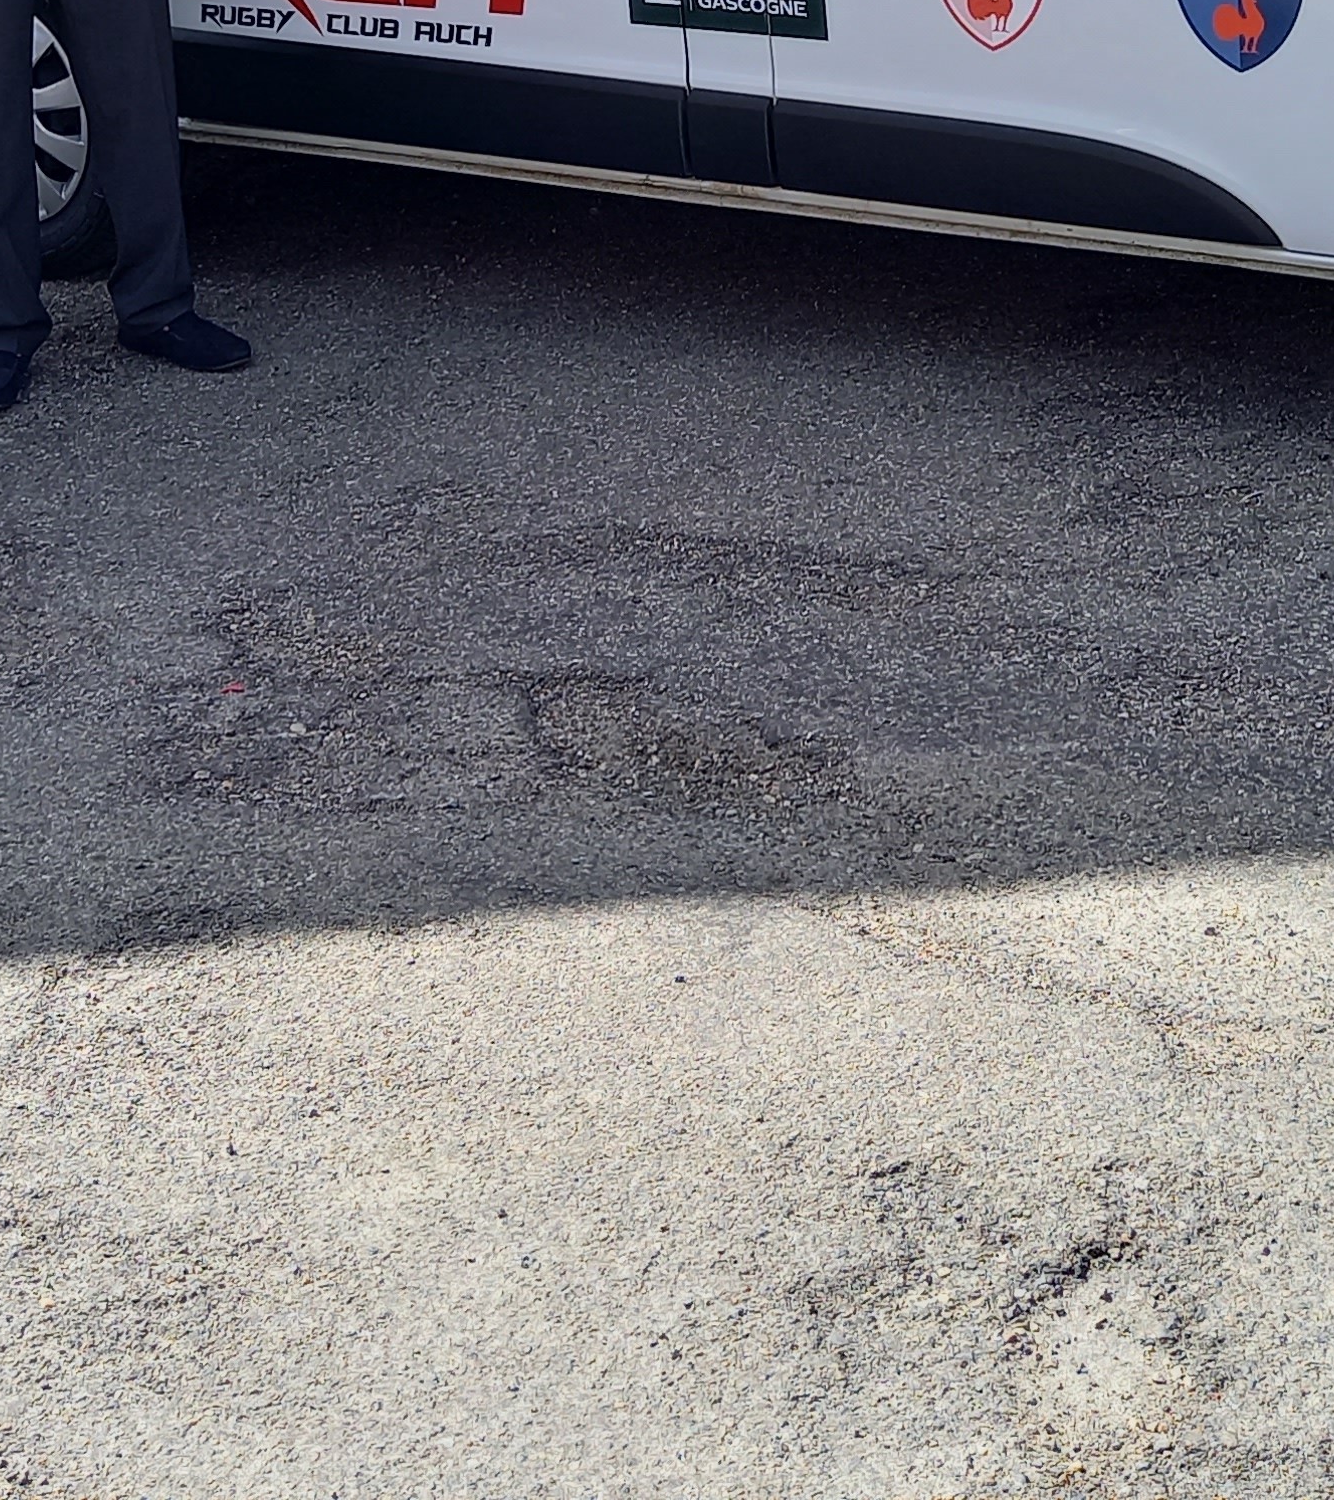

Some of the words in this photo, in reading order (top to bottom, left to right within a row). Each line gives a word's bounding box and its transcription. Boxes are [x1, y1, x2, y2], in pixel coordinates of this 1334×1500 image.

[200, 3, 297, 34] RUGBY
[326, 13, 400, 40] CLUB
[413, 19, 494, 47] AUCH
